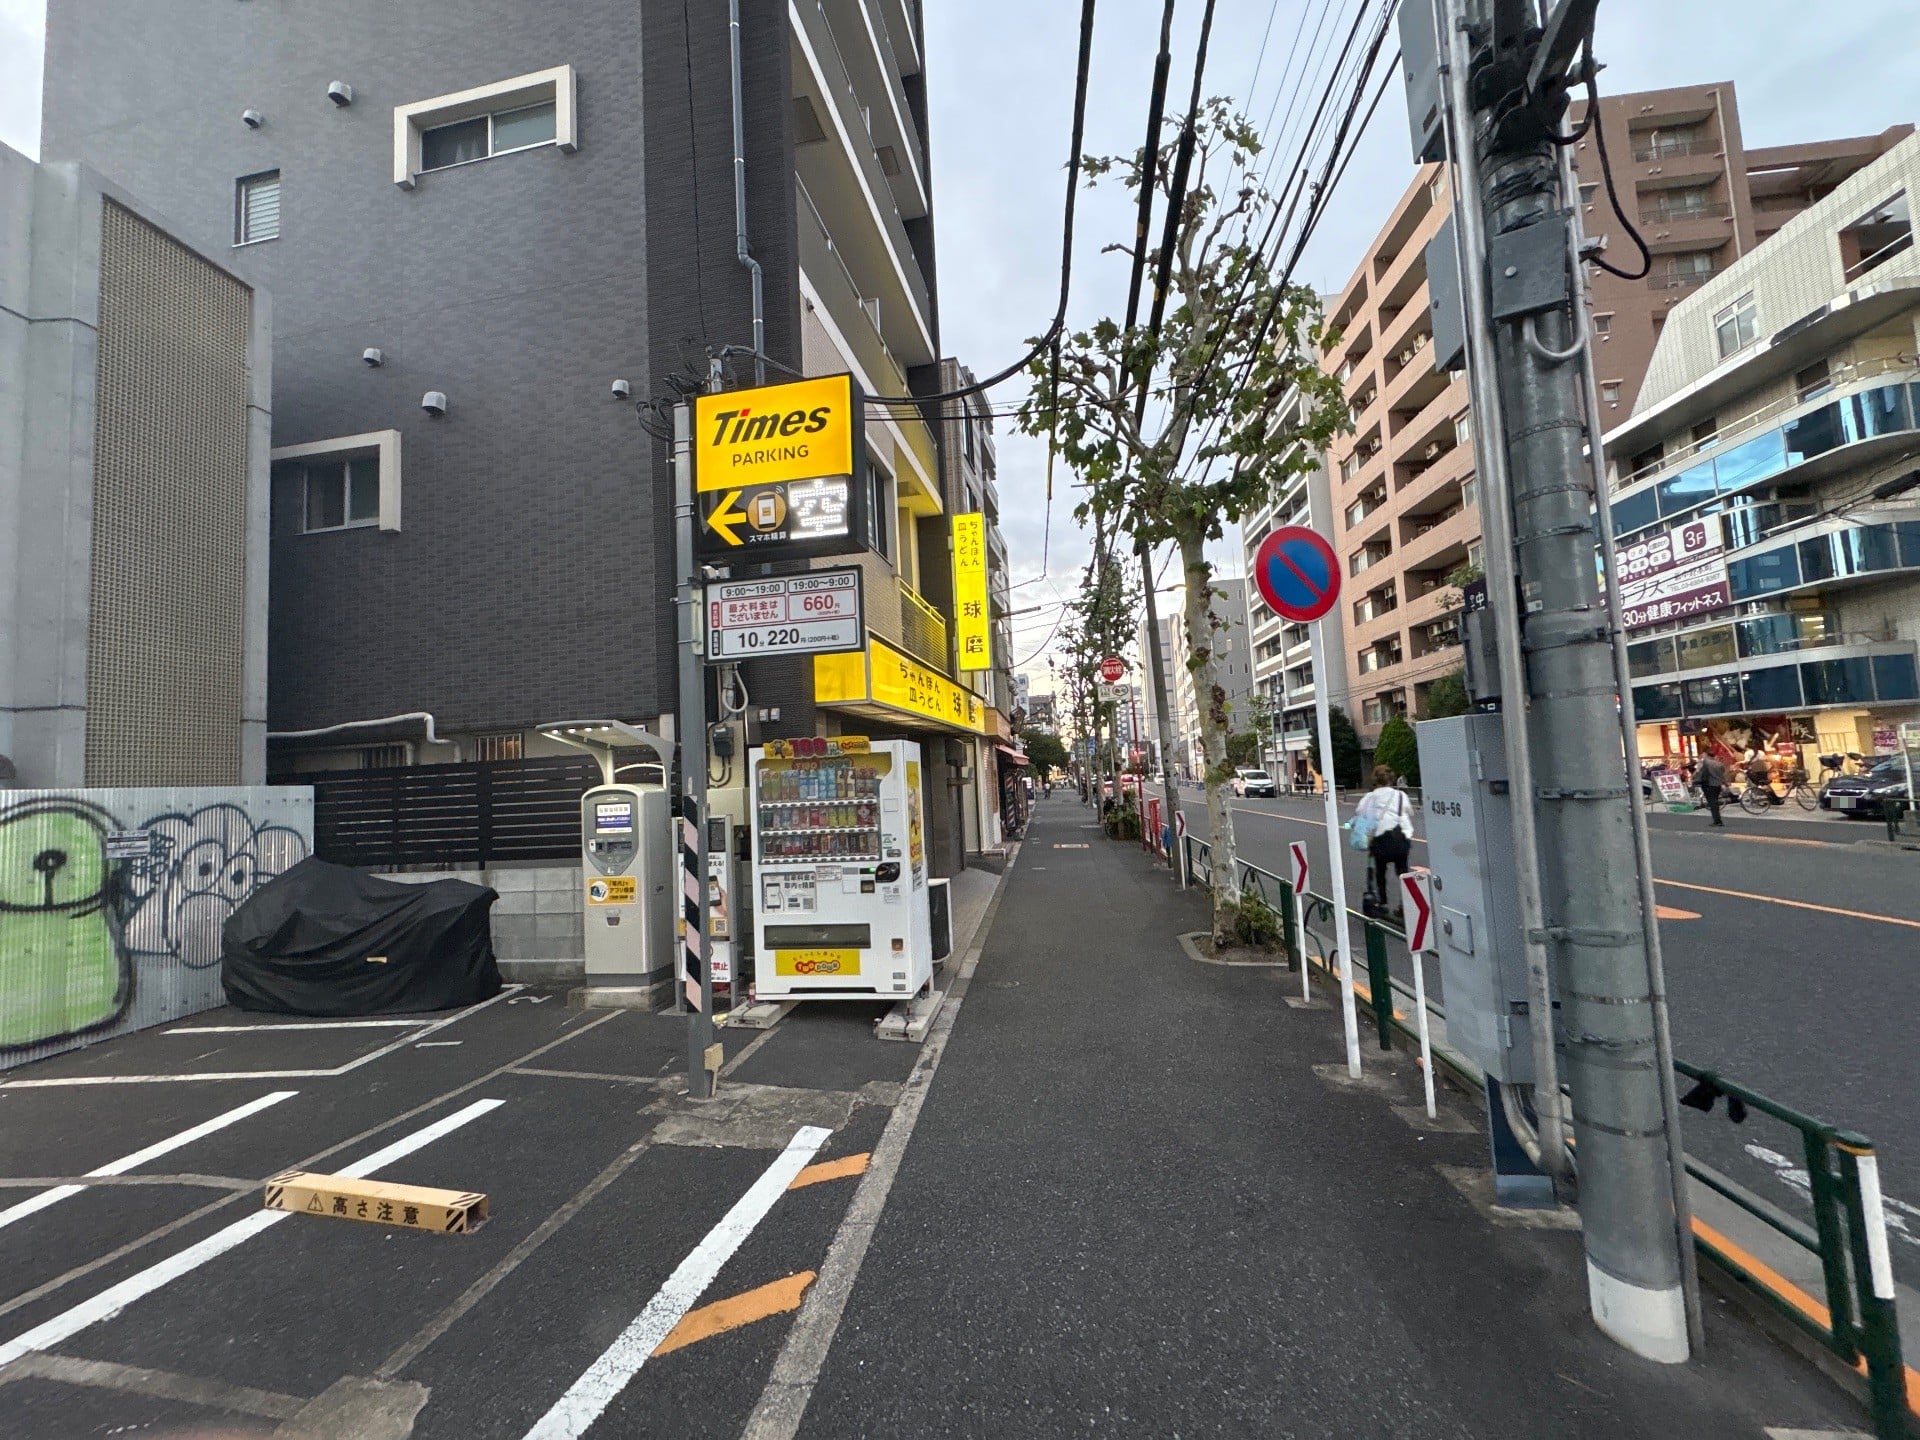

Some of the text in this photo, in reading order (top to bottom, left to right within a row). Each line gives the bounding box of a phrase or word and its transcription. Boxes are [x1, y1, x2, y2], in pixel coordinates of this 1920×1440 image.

[712, 407, 831, 447] Times
[732, 445, 809, 467] PARKING
[1685, 531, 1704, 548] 3F
[729, 601, 778, 612] 最大料金は
[804, 594, 840, 611] 660円
[1623, 592, 1723, 627] 30分健康フィットネス
[963, 600, 984, 653] 球磨
[1431, 801, 1461, 817] 439-56
[333, 1196, 420, 1225] 高さ注意
